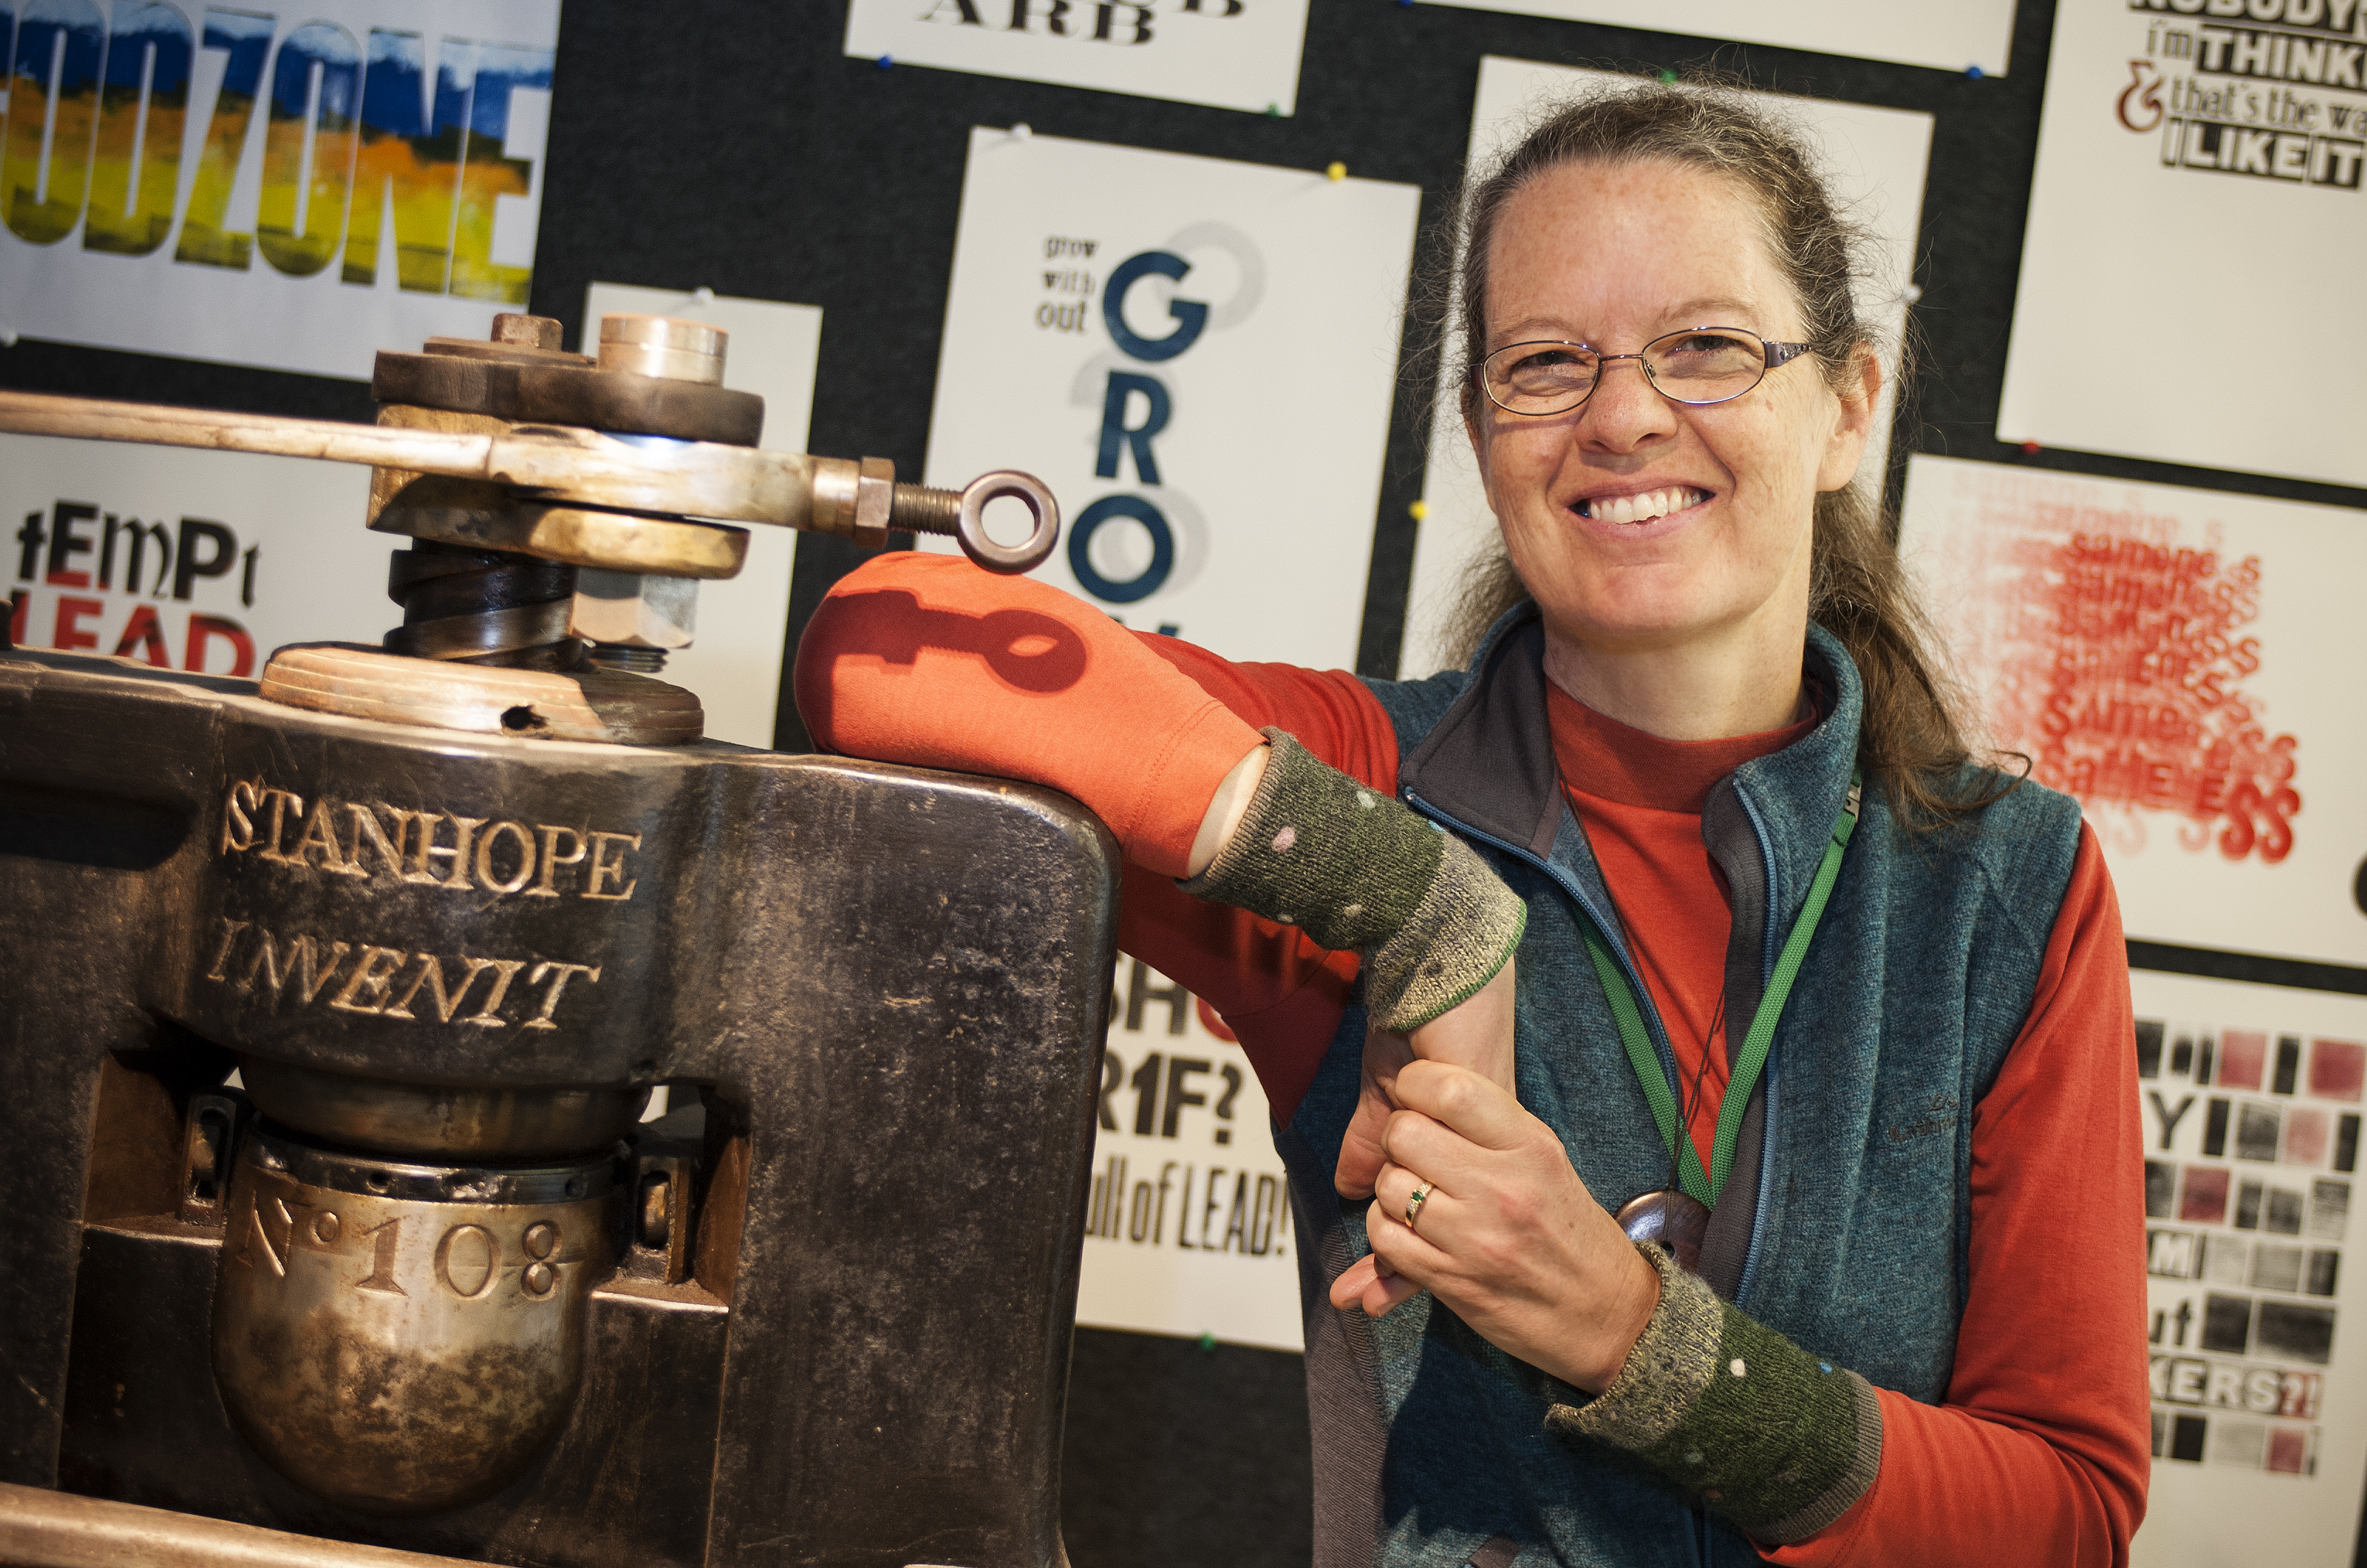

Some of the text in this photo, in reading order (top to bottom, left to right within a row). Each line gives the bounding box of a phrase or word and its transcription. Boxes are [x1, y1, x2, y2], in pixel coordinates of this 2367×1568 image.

[2171, 77, 2260, 123] that's
[2268, 88, 2320, 127] the
[0, 0, 554, 307] ODZONE
[2184, 120, 2307, 181] LIKE
[2312, 136, 2363, 189] IT
[1043, 236, 1098, 258] grow
[1043, 270, 1095, 295] with
[1035, 301, 1089, 333] out
[1067, 249, 1209, 638] GRO
[222, 777, 642, 901] STANHOPE
[207, 917, 602, 1030] INVENIT
[1130, 1160, 1178, 1247] of
[1177, 1163, 1291, 1258] LEAD!
[354, 1217, 563, 1301] 108
